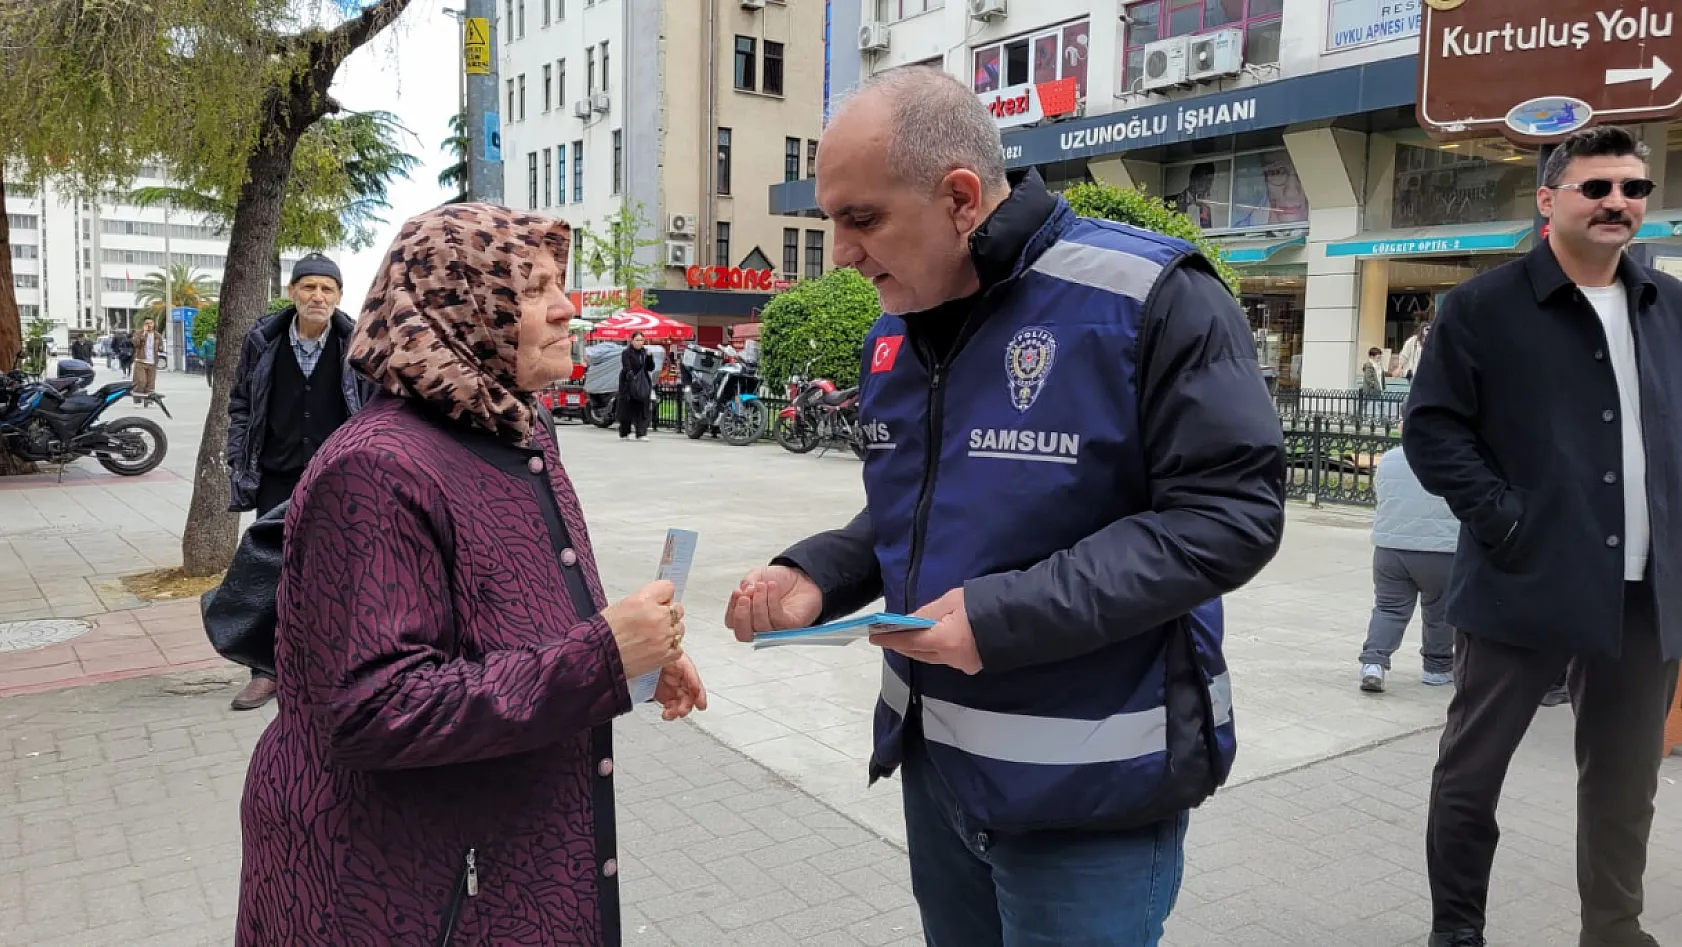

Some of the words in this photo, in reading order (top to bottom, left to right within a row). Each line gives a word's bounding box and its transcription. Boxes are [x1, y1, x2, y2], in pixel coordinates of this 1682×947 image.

[1382, 1, 1421, 16] RES
[1335, 28, 1363, 46] UYKU
[1441, 17, 1590, 58] Kurtuluş
[1596, 7, 1674, 42] Yolu
[986, 88, 1030, 118] rkezi
[1060, 115, 1168, 150] UZUNOĞLU
[1177, 98, 1257, 135] İŞHANI
[969, 428, 1080, 455] SAMSUN
